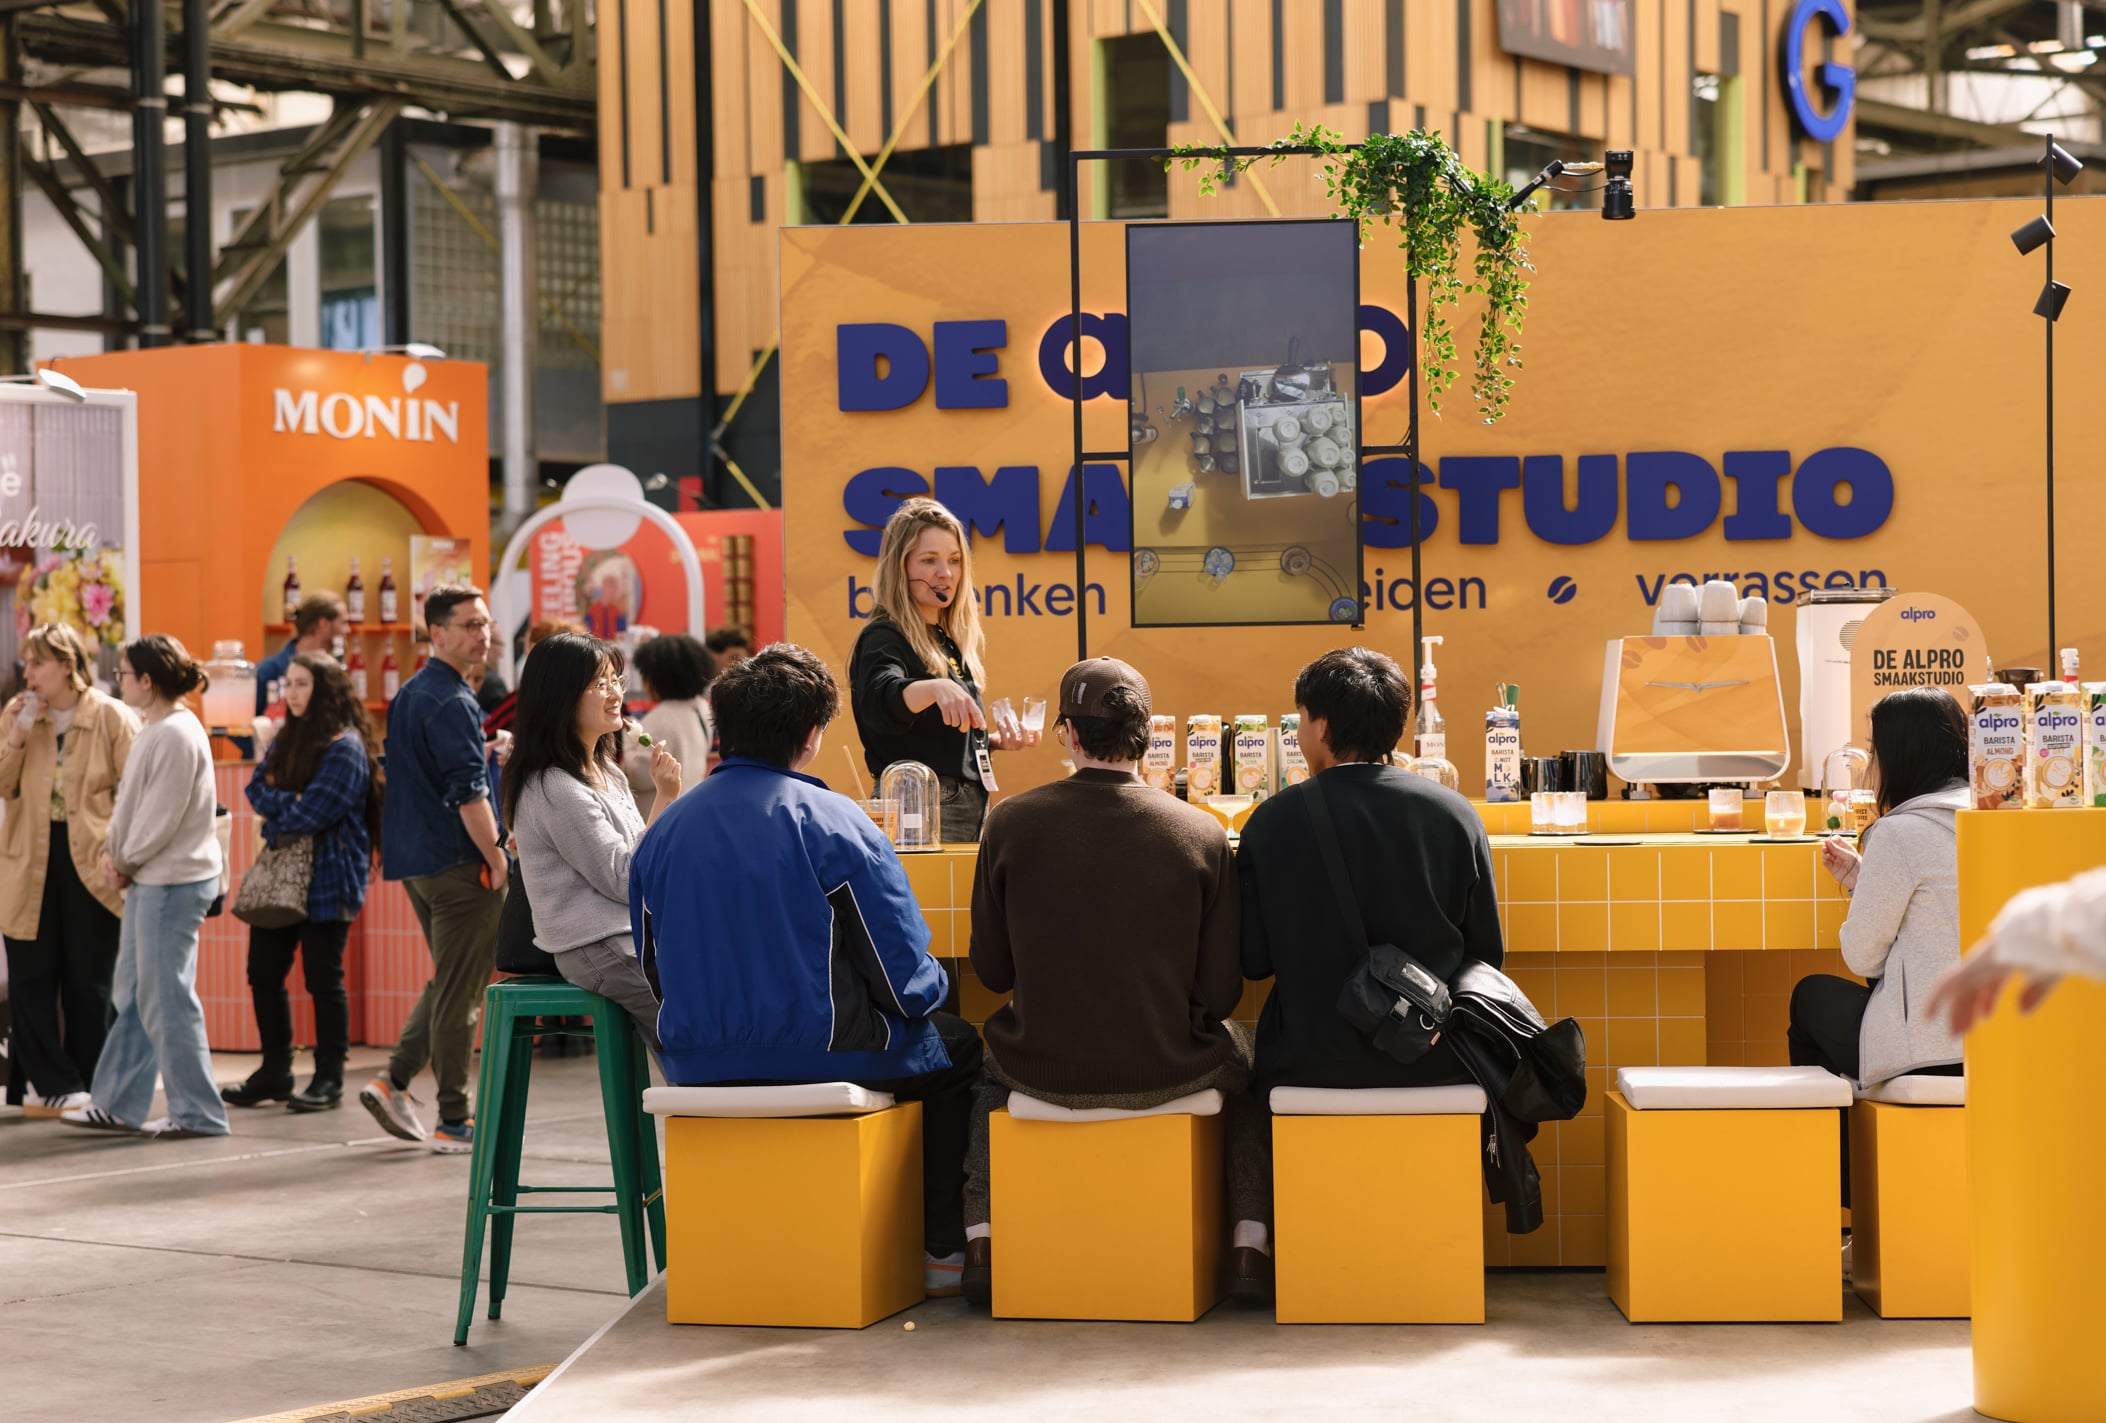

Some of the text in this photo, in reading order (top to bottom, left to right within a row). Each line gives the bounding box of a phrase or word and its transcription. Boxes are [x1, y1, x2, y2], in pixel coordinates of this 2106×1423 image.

[1787, 0, 1857, 141] G
[837, 319, 1008, 412] DE
[273, 388, 459, 444] MONIN
[0, 505, 99, 550] akura
[848, 573, 1106, 619] bnken
[1636, 569, 1887, 606] vassen
[1901, 606, 1936, 623] alpro
[1873, 648, 1964, 670] DE ALPRO
[1874, 671, 1964, 686] SMAAKSTUDIO
[1979, 713, 2019, 732] alpro
[2038, 711, 2078, 730] alpro
[1149, 736, 1172, 750] lpro
[1189, 736, 1217, 749] alpro
[1237, 736, 1265, 749] alpro
[1283, 735, 1300, 748] alp
[1488, 733, 1517, 746] alpro
[1984, 736, 2016, 745] BARISTA
[2042, 734, 2075, 743] BARISTA
[1986, 747, 2014, 755] ALMOND
